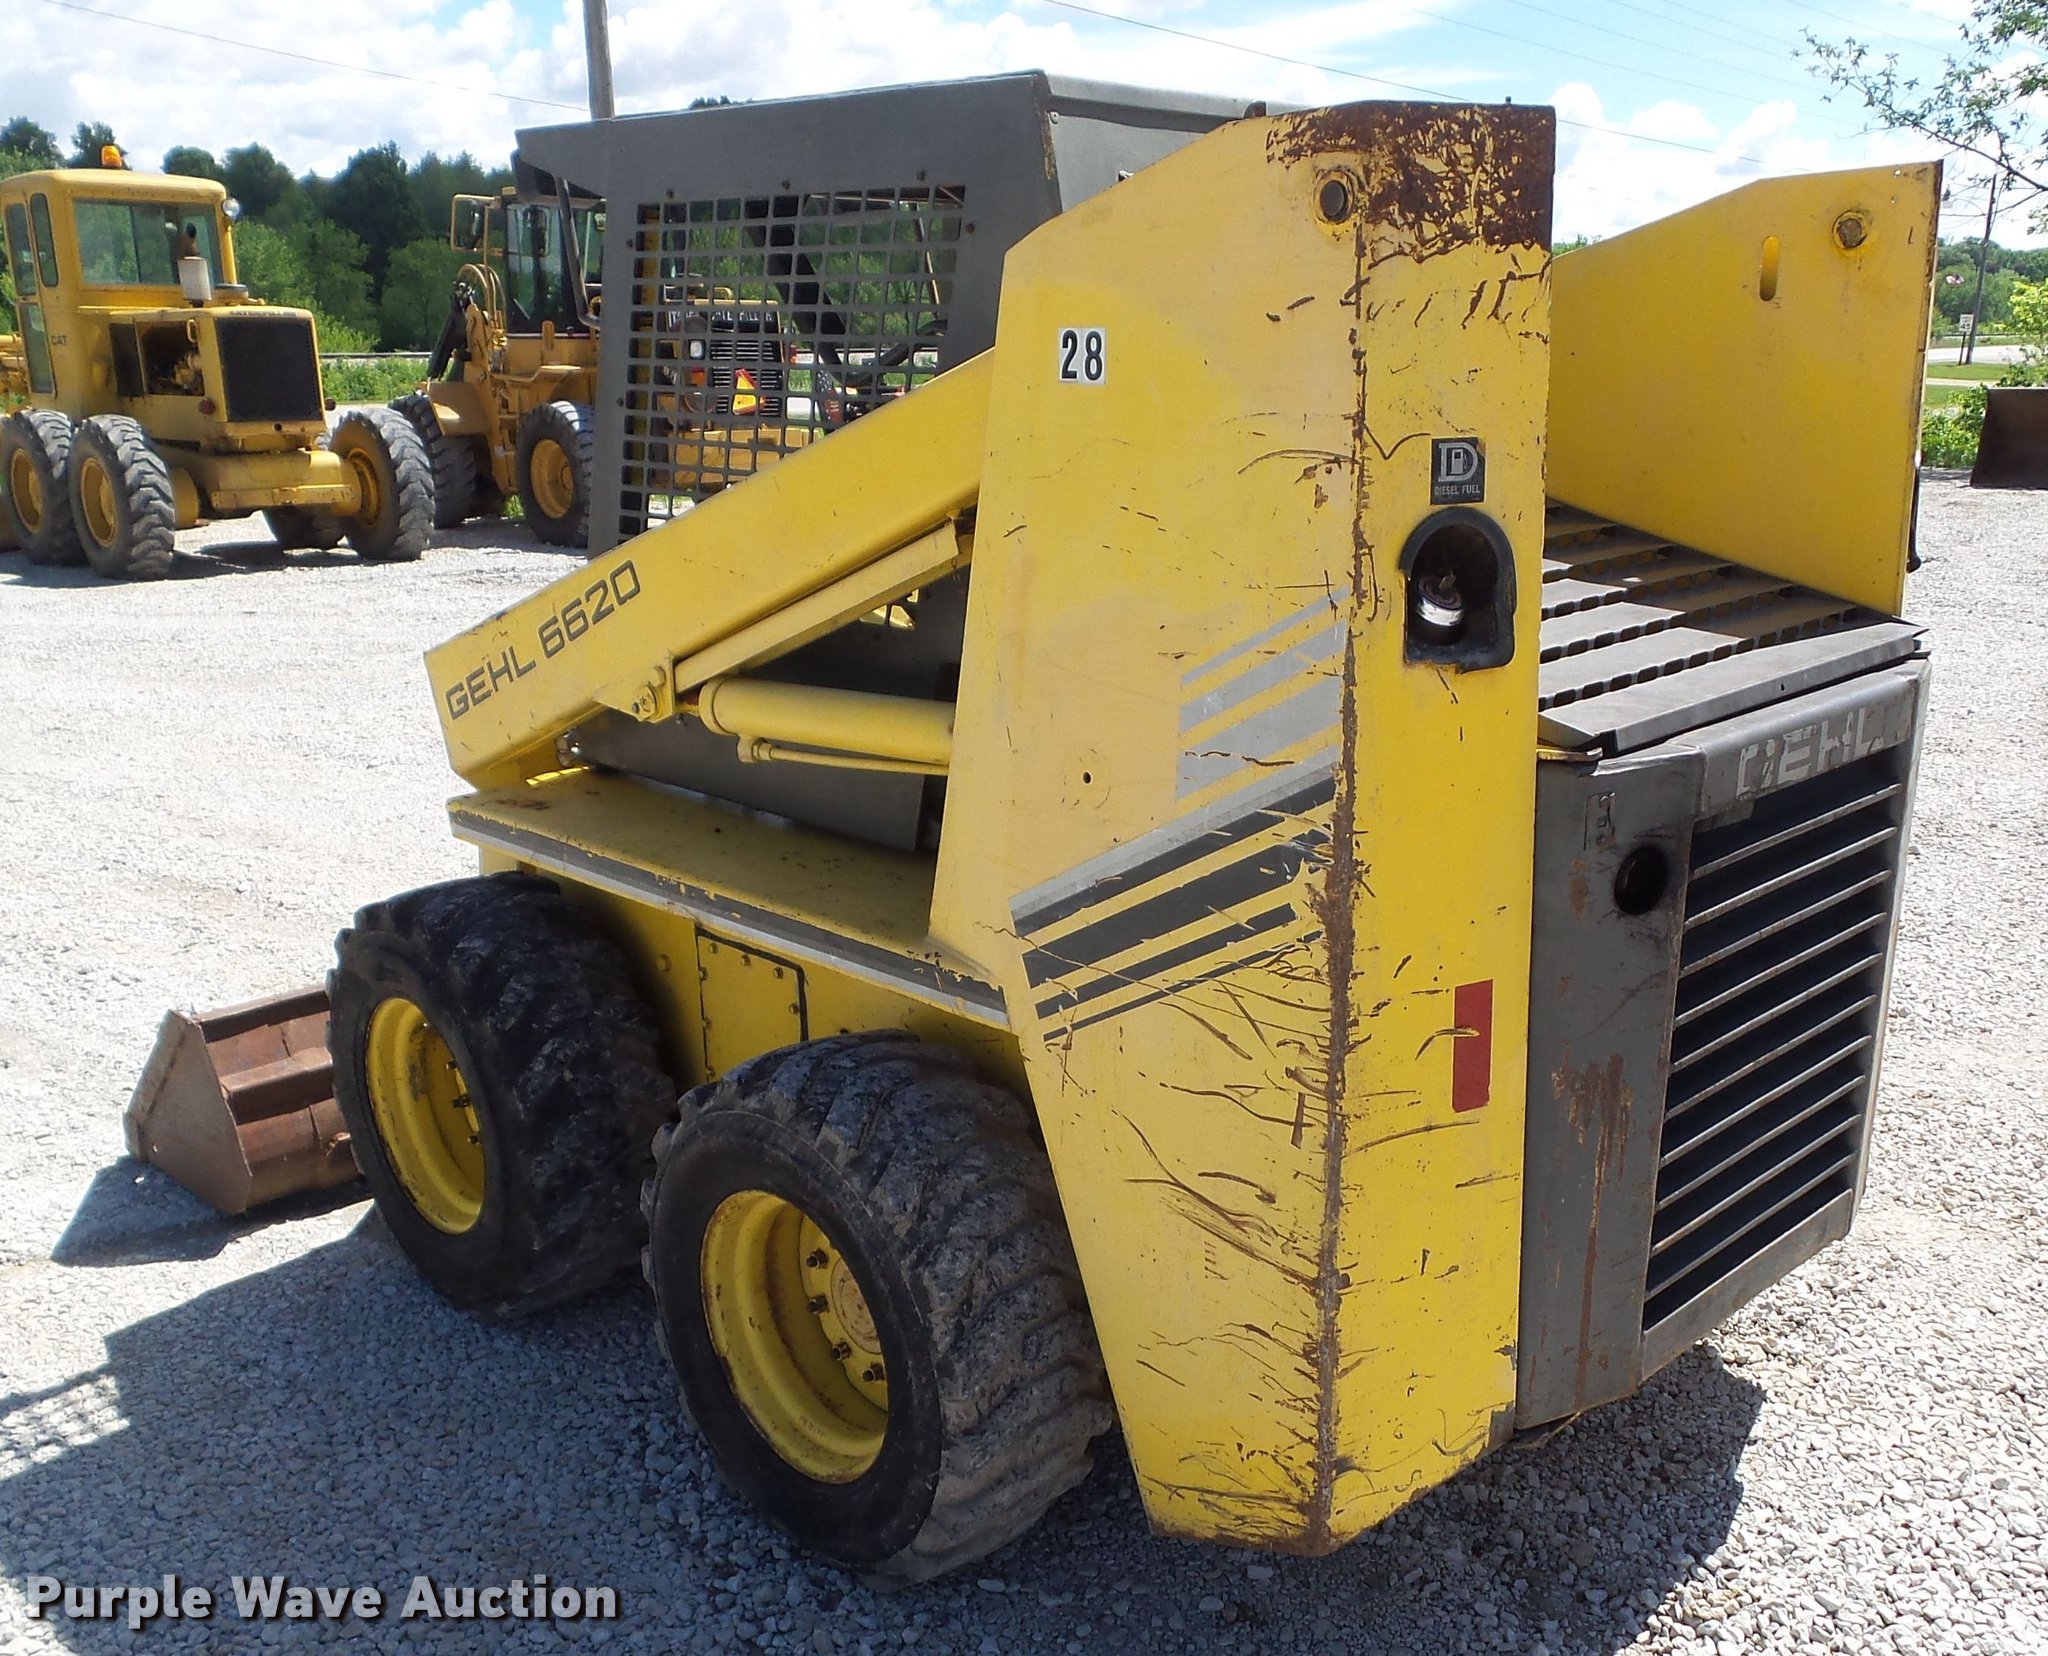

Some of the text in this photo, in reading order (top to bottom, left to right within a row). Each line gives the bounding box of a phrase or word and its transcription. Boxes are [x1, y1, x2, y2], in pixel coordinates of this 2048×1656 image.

[1061, 329, 1103, 381] 28
[1434, 484, 1481, 496] DIESEL FUEL
[445, 559, 641, 721] GEHL 6620
